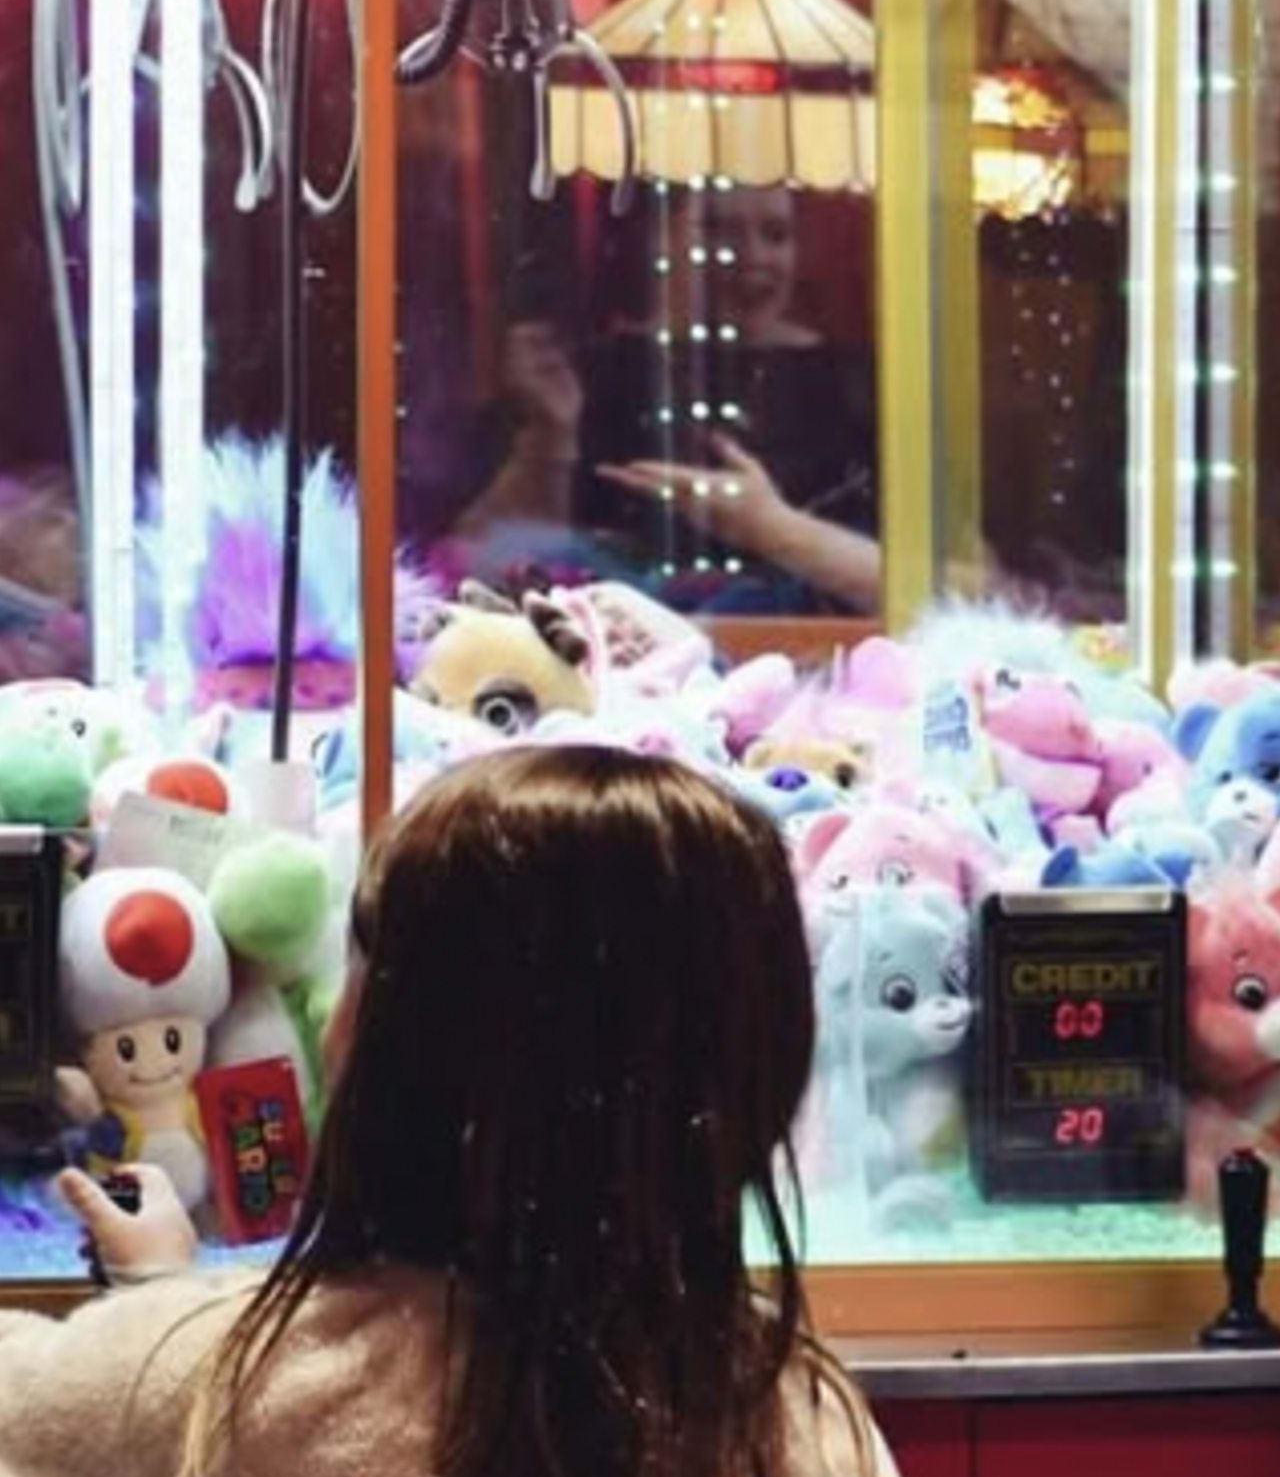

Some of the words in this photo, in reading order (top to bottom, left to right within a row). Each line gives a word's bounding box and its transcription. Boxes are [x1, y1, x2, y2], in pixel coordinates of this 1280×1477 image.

[1011, 962, 1157, 993] CREDIT
[1055, 1001, 1104, 1040] 00
[1026, 1067, 1144, 1098] TIMER
[1055, 1107, 1104, 1143] 20
[258, 1099, 298, 1195] SUER
